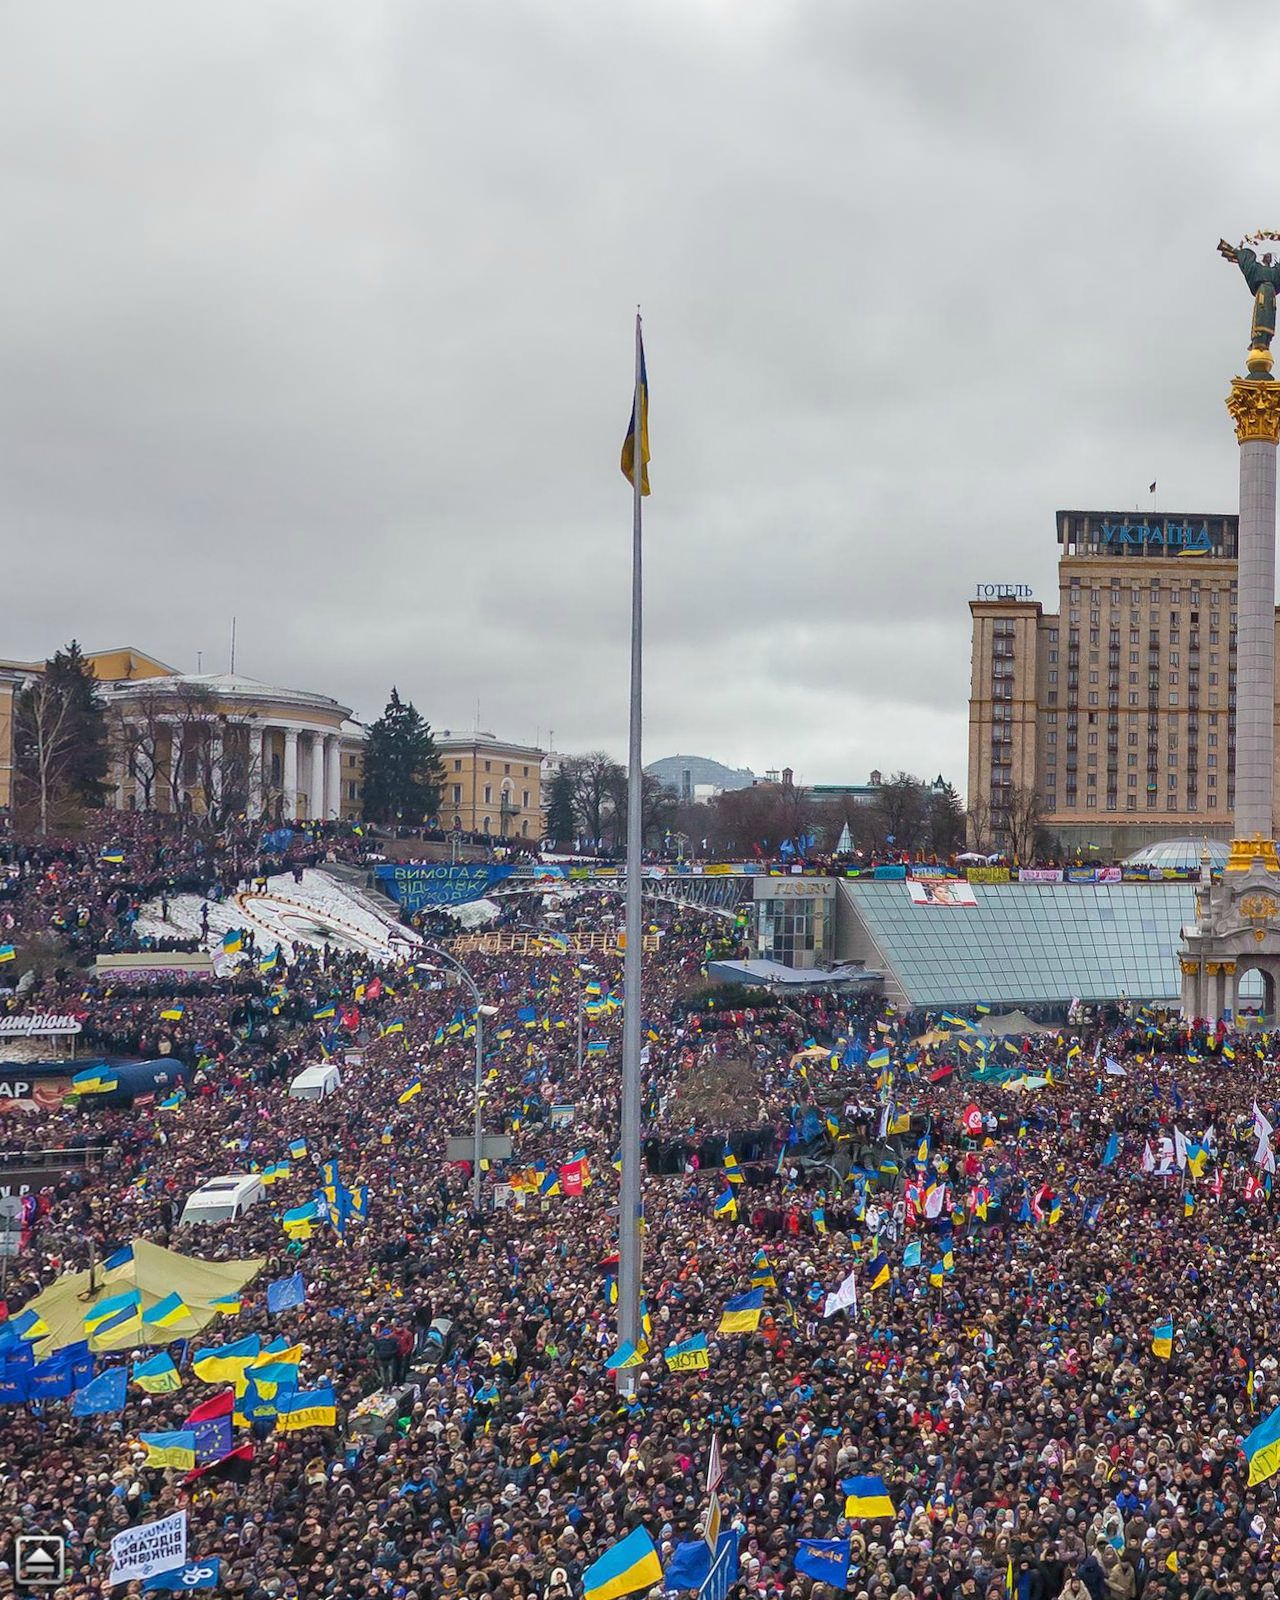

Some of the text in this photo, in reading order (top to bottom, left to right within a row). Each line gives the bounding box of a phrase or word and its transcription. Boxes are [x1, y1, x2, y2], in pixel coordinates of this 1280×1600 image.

[1100, 523, 1210, 546] УКРАЇНА
[976, 584, 1033, 598] ГОТЕЛЬ
[394, 867, 469, 880] ВИМОГА
